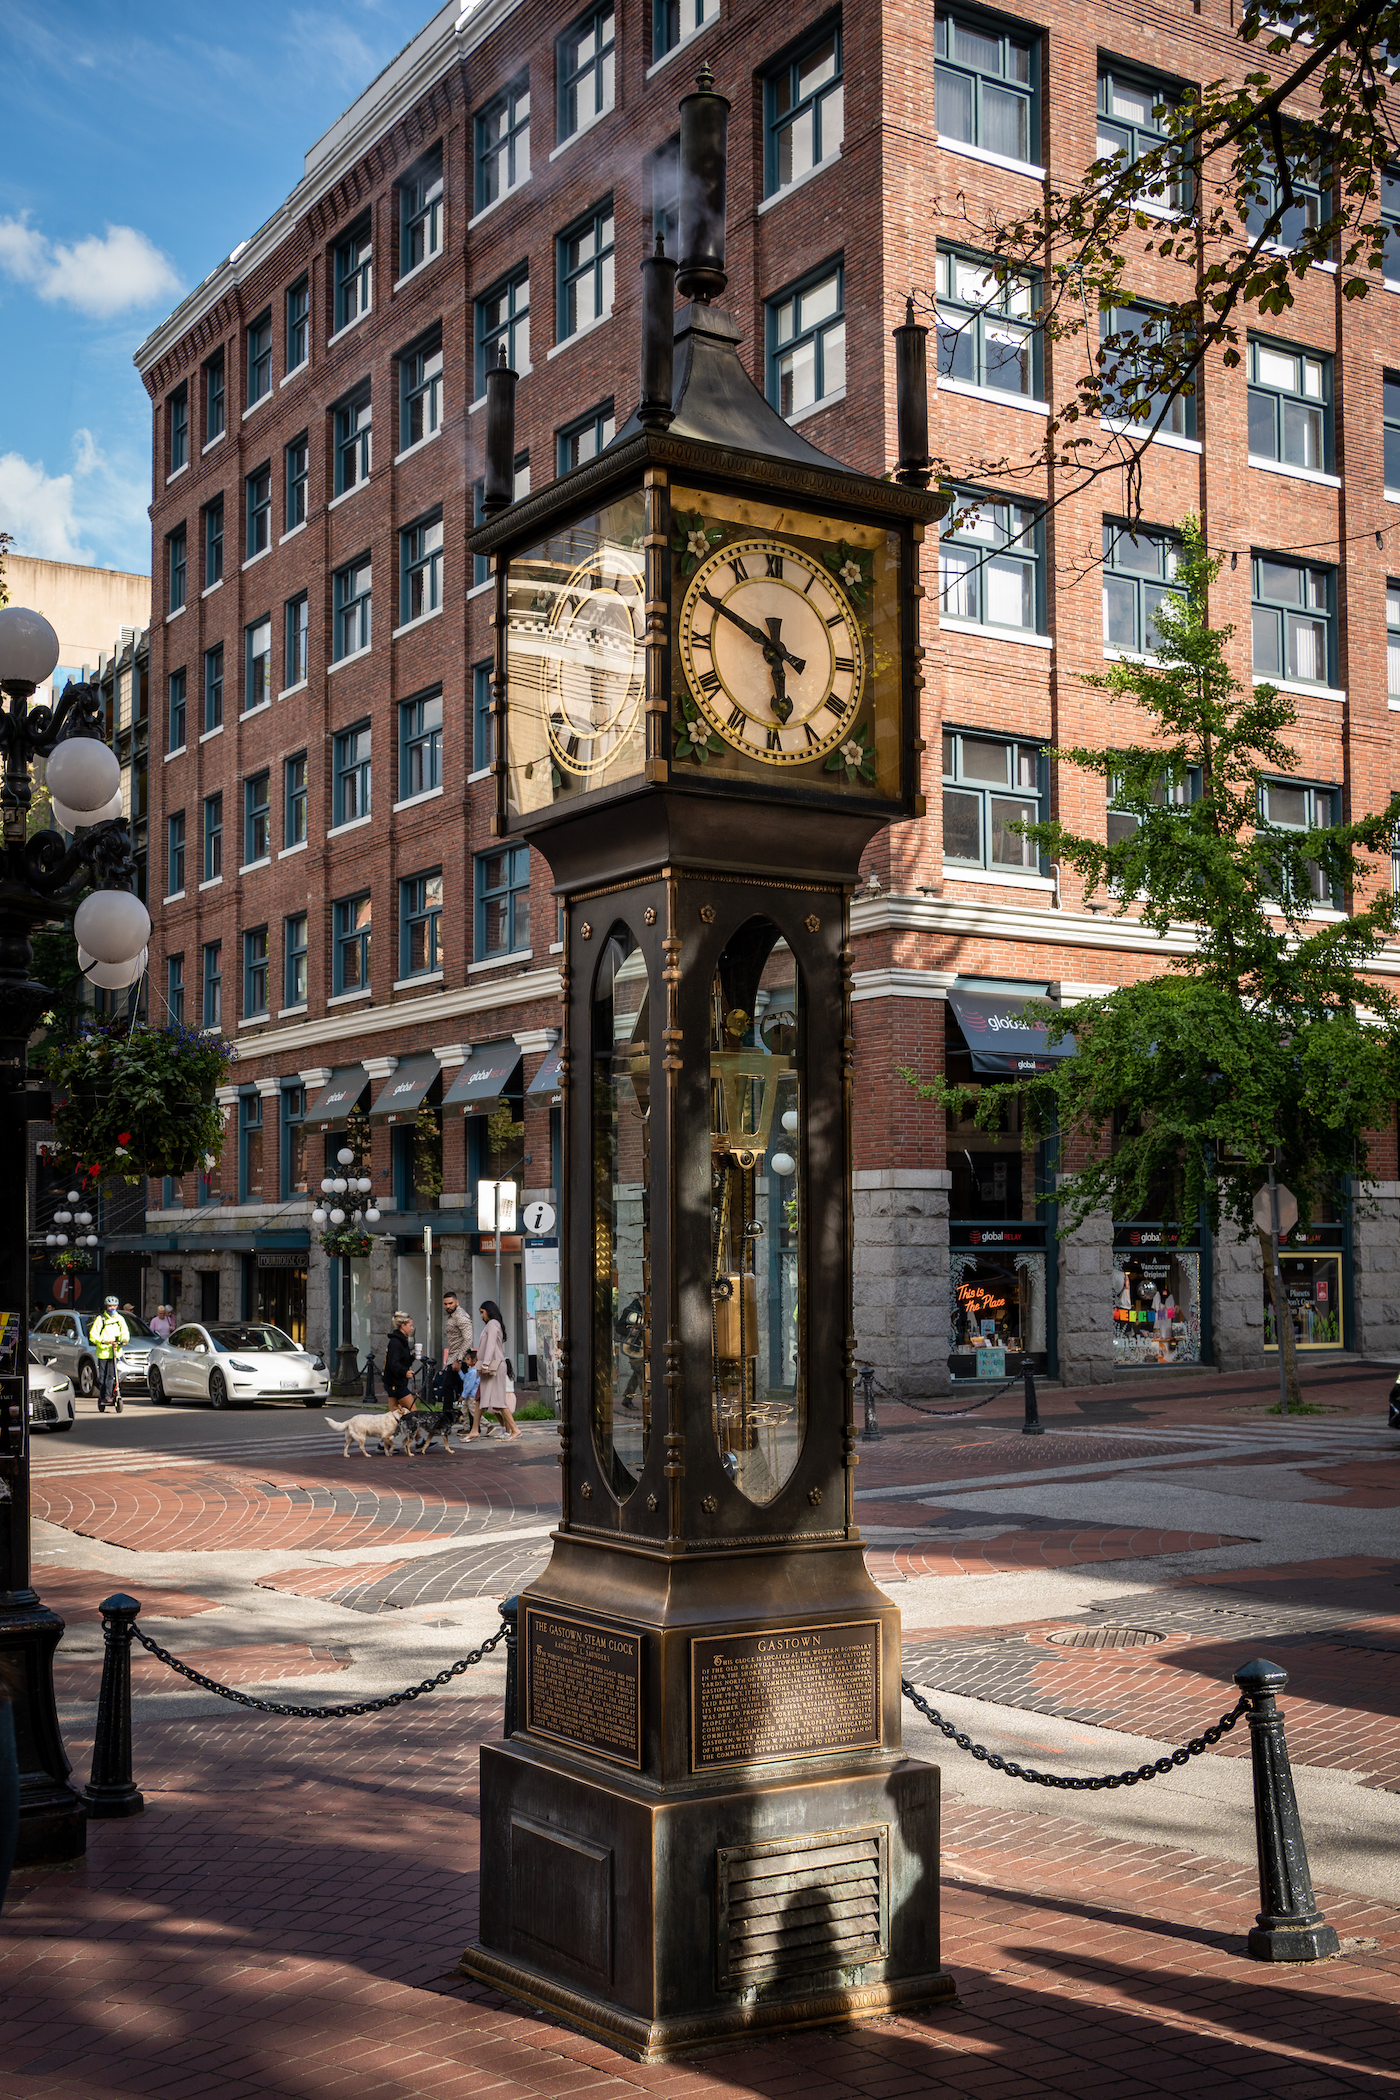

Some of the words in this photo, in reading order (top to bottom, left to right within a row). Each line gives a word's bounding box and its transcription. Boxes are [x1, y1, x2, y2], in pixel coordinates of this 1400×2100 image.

[1017, 1060, 1036, 1070] global
[467, 1068, 493, 1085] global
[982, 1231, 1003, 1242] global
[1140, 1263, 1171, 1271] Vancouver
[1143, 1271, 1168, 1279] Original
[956, 1283, 976, 1301] This
[976, 1287, 984, 1298] is
[965, 1300, 981, 1312] the
[981, 1294, 1005, 1309] Place
[535, 1620, 547, 1632] THE
[549, 1624, 582, 1642] GASTOWN
[584, 1633, 606, 1648] STEAM
[608, 1639, 633, 1655] CLOCK
[757, 1635, 821, 1652] GASTOWN
[713, 1654, 733, 1666] THIS
[763, 1653, 790, 1661] LOCATED
[812, 1647, 838, 1655] WESTERN
[713, 1654, 733, 1666] THIS
[792, 1669, 819, 1677] THROUGH
[740, 1661, 775, 1670] GRANVILLE
[771, 1665, 800, 1673] BURRARD
[701, 1686, 730, 1694] GASTOWN
[762, 1678, 800, 1687] COMMERCIAL
[802, 1674, 825, 1682] CENTRE
[701, 1719, 725, 1727] PEOPLE
[738, 1714, 769, 1722] GASTOWN
[771, 1709, 802, 1718] WORKING
[804, 1705, 836, 1714] TOGETHER
[713, 1704, 739, 1712] FORMER
[742, 1707, 772, 1715] PROPERTY
[701, 1725, 731, 1733] COUNCIL
[840, 1707, 871, 1715] TOWNSITE
[742, 1725, 775, 1734] COMPOSED
[802, 1718, 833, 1726] PROPERTY
[836, 1714, 862, 1722] OWNERS
[755, 1729, 795, 1739] RESPONSIBLE
[824, 1719, 872, 1730] BEAUTIFICATION
[779, 1735, 802, 1743] PARKER
[833, 1727, 864, 1735] CHAIRMAN
[716, 1749, 751, 1758] COMMITTEE
[754, 1744, 783, 1753] BETWEEN
